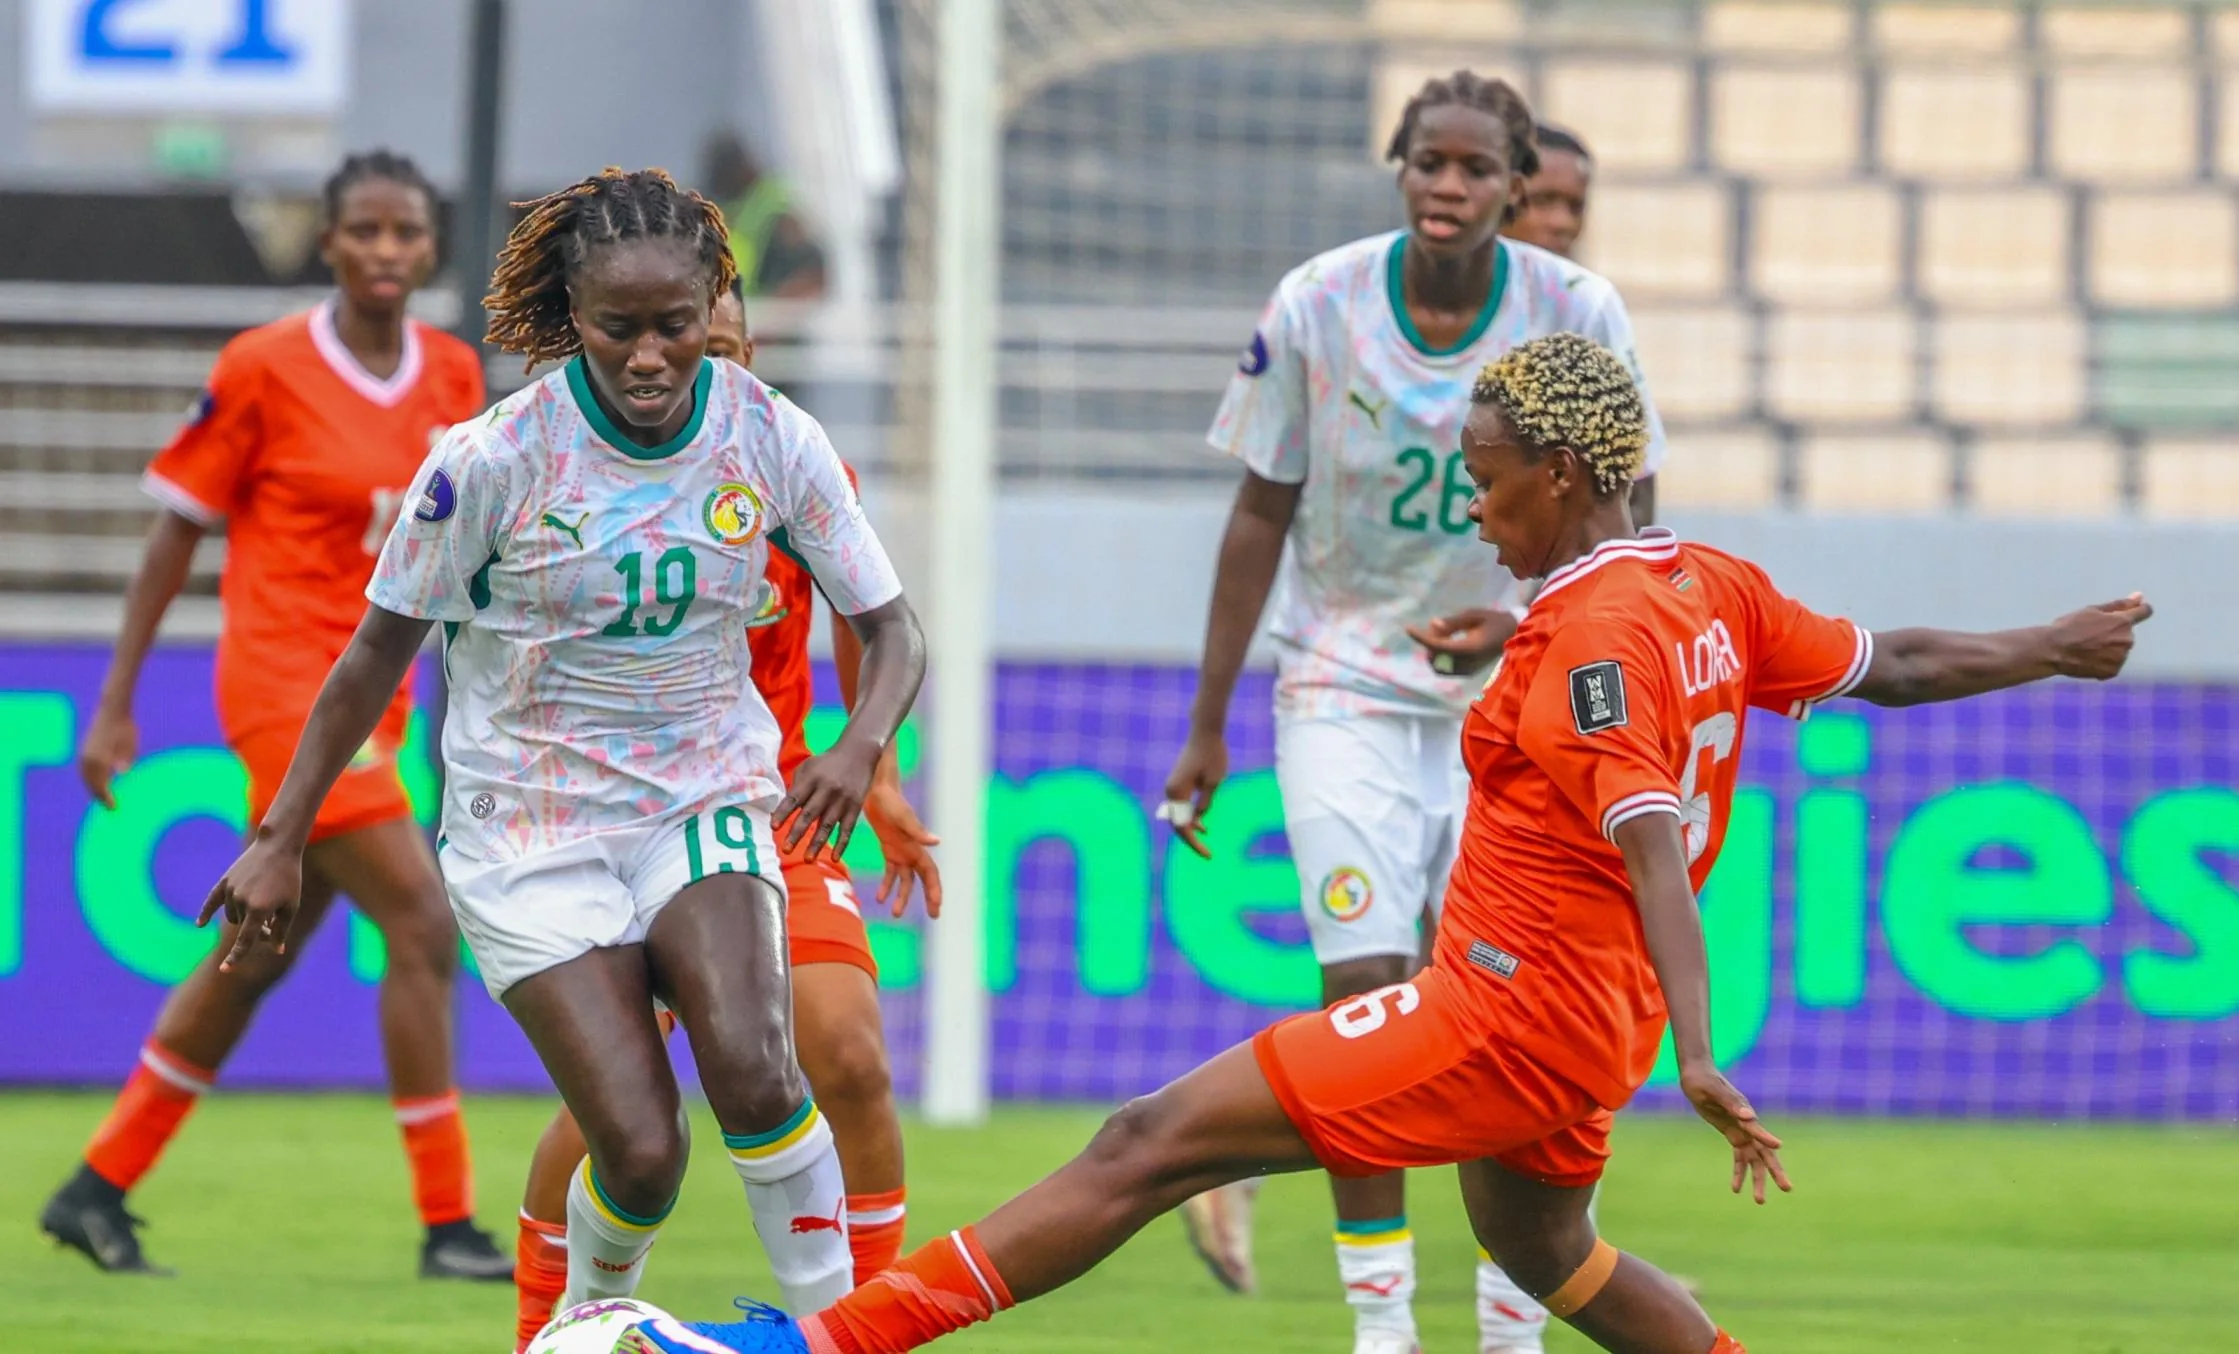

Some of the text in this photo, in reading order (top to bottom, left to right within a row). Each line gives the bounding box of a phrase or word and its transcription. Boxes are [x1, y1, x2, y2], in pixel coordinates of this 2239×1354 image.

[1391, 447, 1475, 535] 26
[601, 546, 696, 636] 19
[1680, 711, 1737, 868] 6
[684, 806, 760, 883] 19
[1330, 983, 1419, 1039] 6
